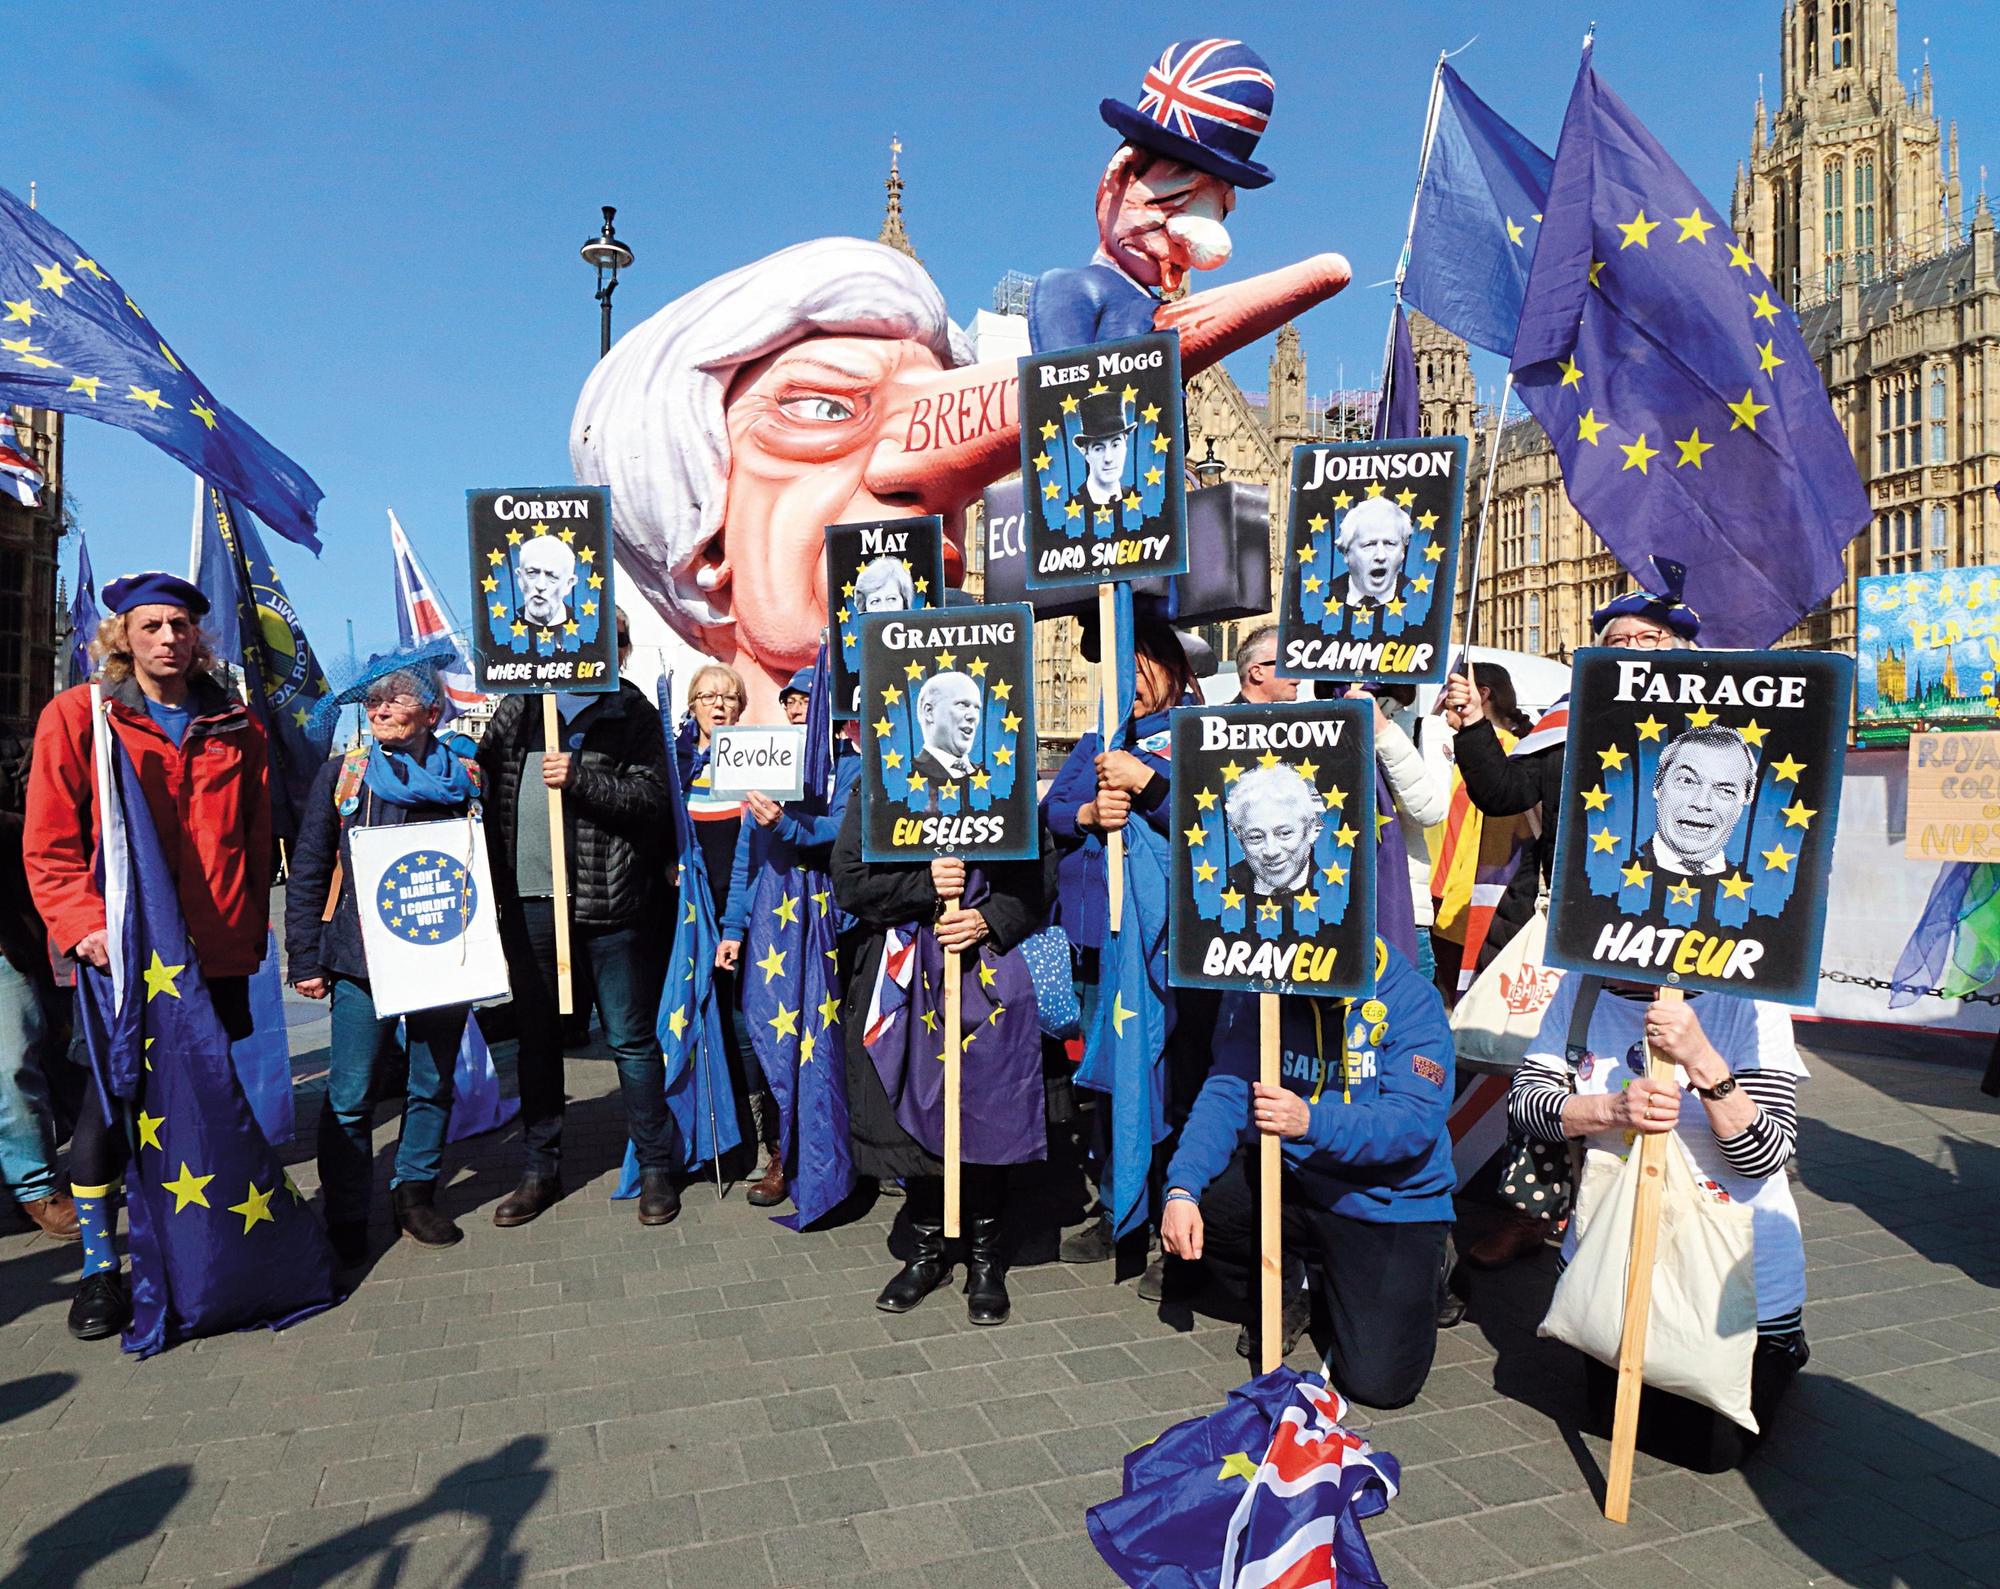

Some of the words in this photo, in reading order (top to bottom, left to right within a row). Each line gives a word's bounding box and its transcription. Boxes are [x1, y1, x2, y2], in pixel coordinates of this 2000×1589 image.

[1039, 364, 1089, 388] REES
[1097, 350, 1163, 378] MOGG
[1302, 449, 1454, 491] JOHNSON
[494, 495, 589, 520] CORBYN
[860, 527, 909, 555] MAY
[1038, 544, 1086, 574] LORD
[1091, 534, 1170, 567] SNEUTY
[881, 622, 1016, 650] GRAYLING
[487, 663, 533, 681] WHERE
[536, 662, 573, 680] WERE
[577, 661, 606, 679] EU?
[1286, 639, 1434, 673] SCAMMEUR
[1613, 660, 1808, 708] FARAGE
[1200, 716, 1346, 751] BERCOW
[716, 736, 792, 767] Revoke
[892, 815, 1004, 846] EUSELESS
[400, 882, 435, 900] BLAME
[435, 880, 455, 894] ME.
[410, 869, 441, 885] DON'T
[401, 904, 407, 916] I
[407, 896, 456, 915] COULDN'T
[416, 911, 445, 926] VOTE
[1203, 936, 1338, 982] BRAVEU
[1592, 921, 1764, 980] HATEUR
